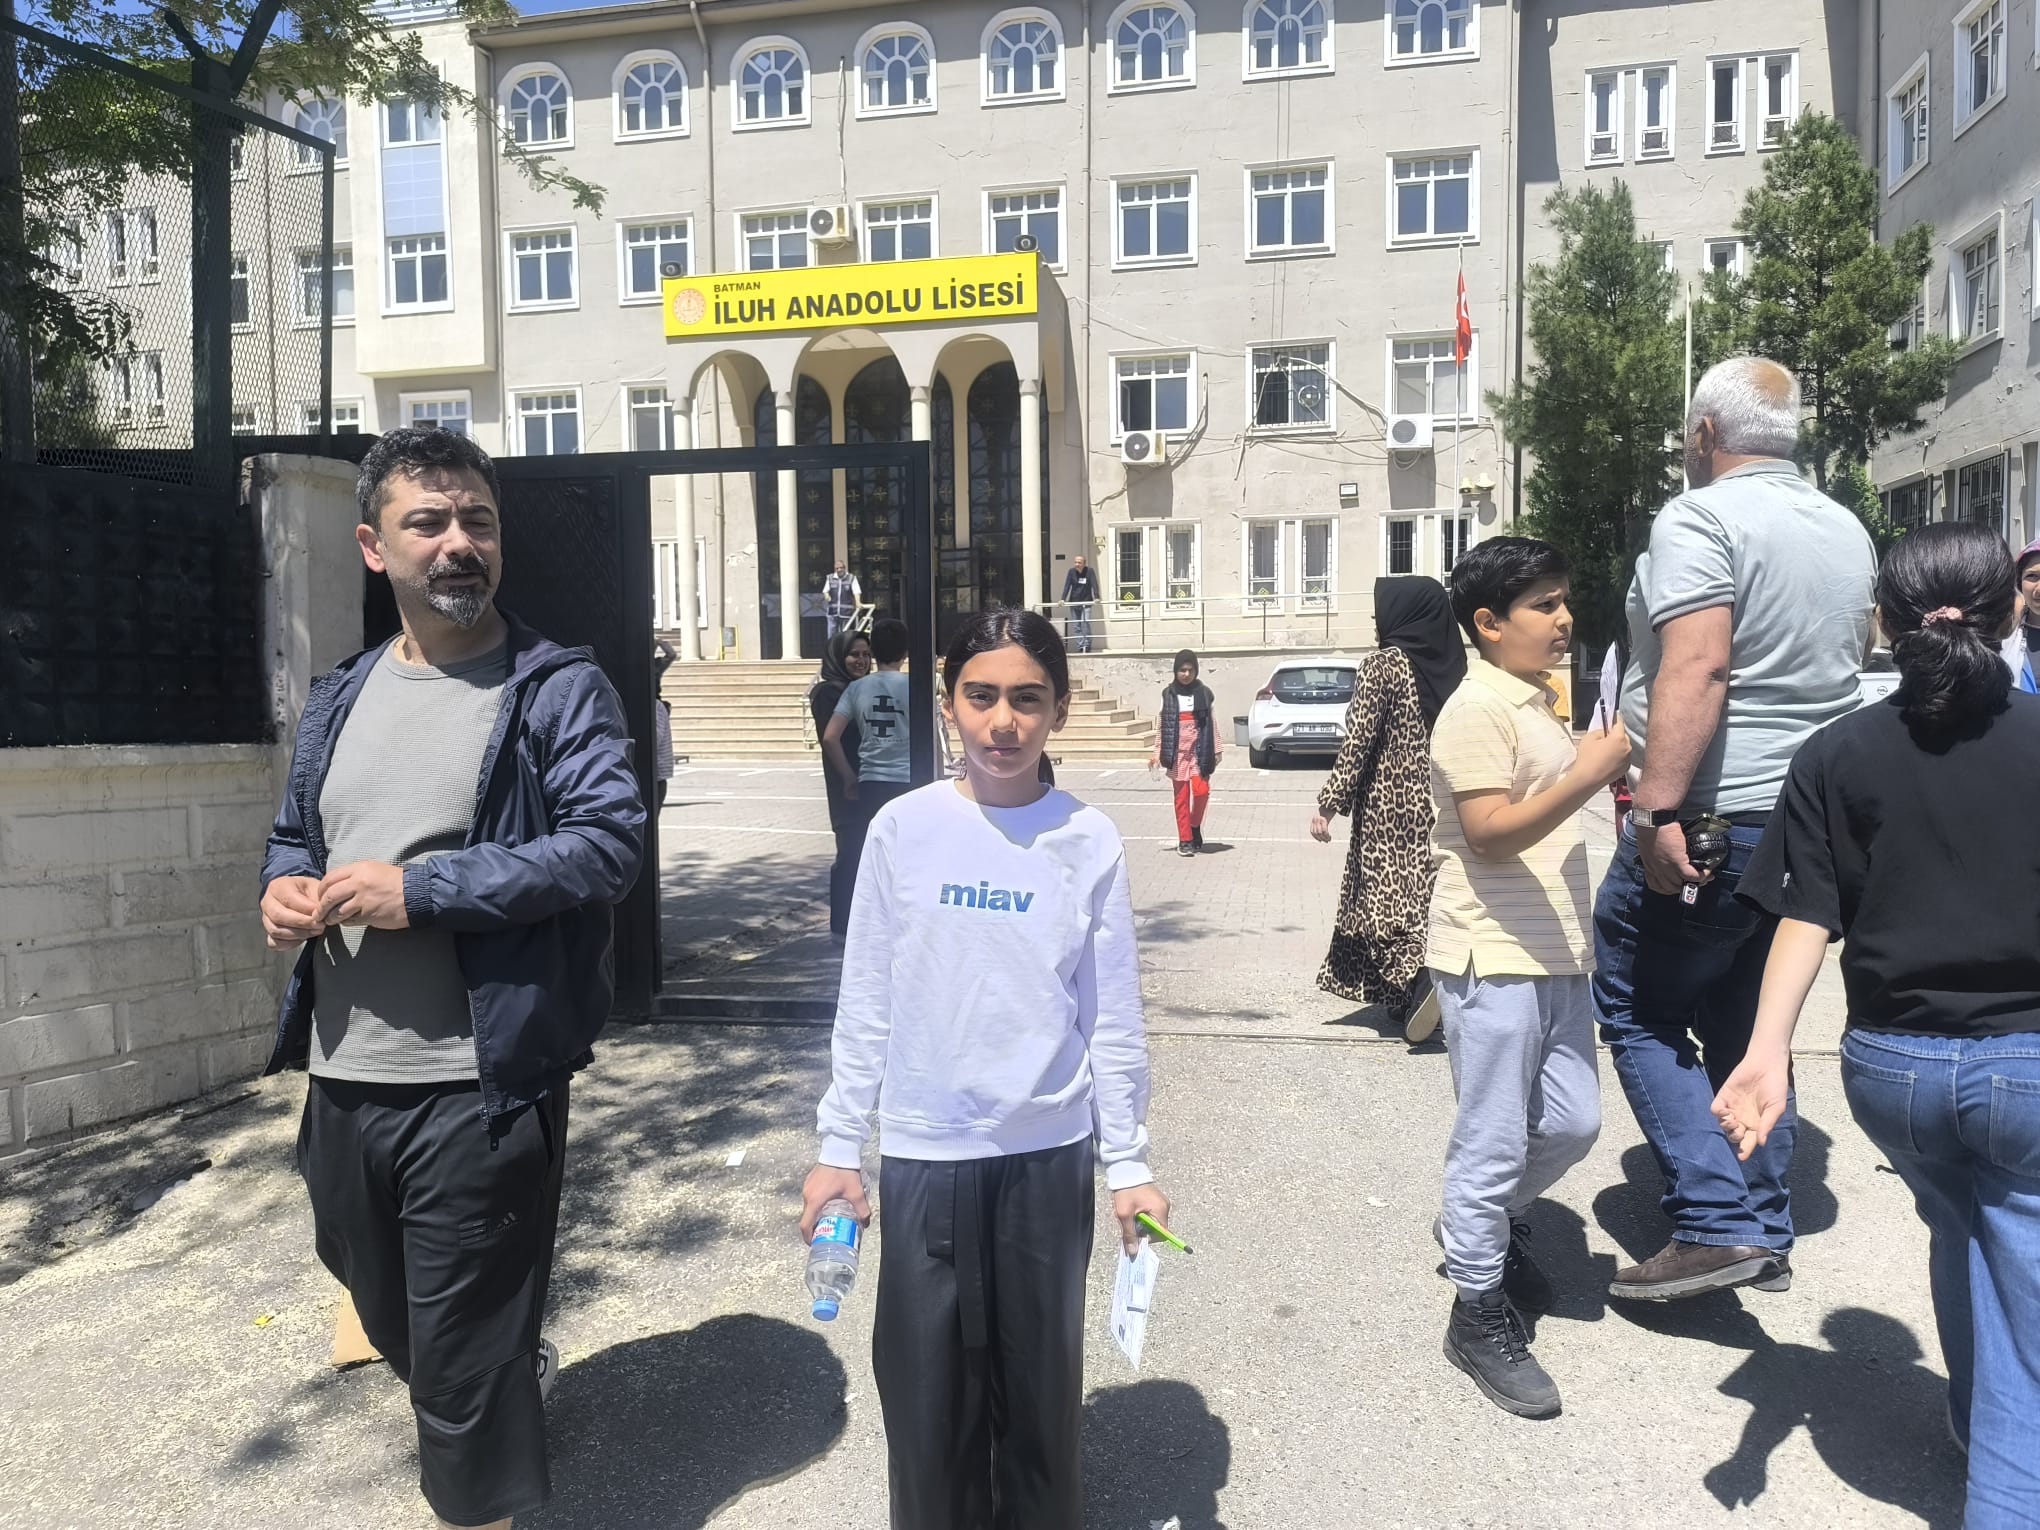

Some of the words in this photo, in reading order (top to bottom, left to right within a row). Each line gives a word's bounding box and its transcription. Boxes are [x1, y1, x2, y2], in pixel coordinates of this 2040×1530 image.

[713, 281, 761, 293] BATMAN
[714, 294, 775, 325] İLUH
[786, 289, 922, 320] ANADOLU
[932, 273, 1024, 310] LİSESİ
[940, 880, 1035, 912] miav
